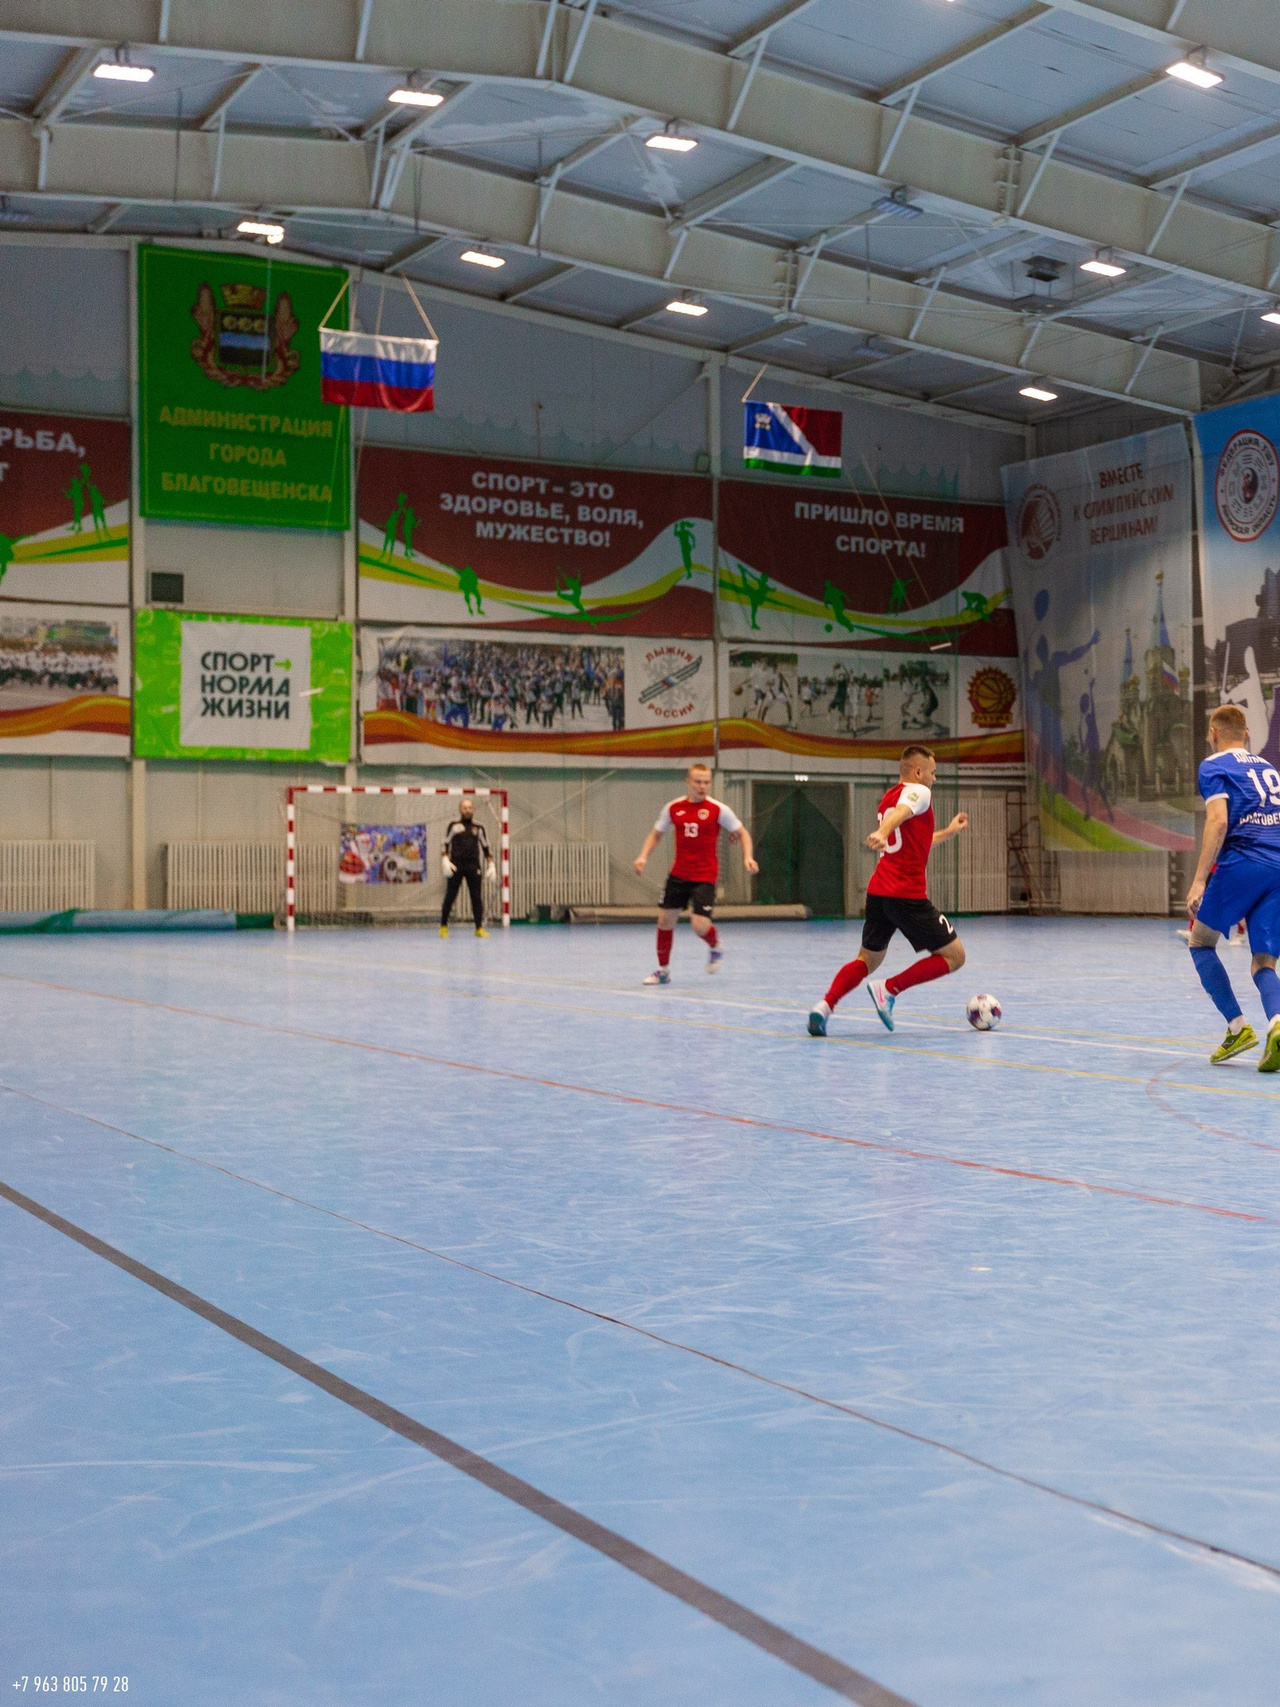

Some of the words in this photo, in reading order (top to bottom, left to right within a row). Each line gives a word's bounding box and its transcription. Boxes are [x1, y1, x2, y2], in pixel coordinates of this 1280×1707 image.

[160, 405, 333, 438] АДМИНИСТРАЦИЯ
[210, 443, 287, 467] ГОРОДА
[161, 471, 332, 503] БЛАГОВЕЩЕНСКА
[472, 471, 549, 495] СПОРТ
[569, 481, 615, 500] ЭТО
[1098, 462, 1143, 489] ВМЕСТЕ
[439, 492, 571, 523] ЗДОРОВЬЕ,
[577, 505, 644, 530] ВОЛЯ,
[1083, 484, 1174, 520] ОЛИМПИЙСКИМ
[795, 501, 889, 526] ПРИШЛО
[896, 511, 964, 533] ВРЕМЯ
[475, 521, 611, 548] МУЖЕСТВО!
[836, 534, 926, 558] СПОРТА!
[201, 651, 275, 673] СПОРТ
[646, 646, 694, 662] ЛЫЖНЯ
[201, 674, 290, 697] НОРМА
[201, 697, 290, 719] ЖИЗНИ
[647, 702, 694, 718] РОССИИ
[684, 822, 699, 838] 13
